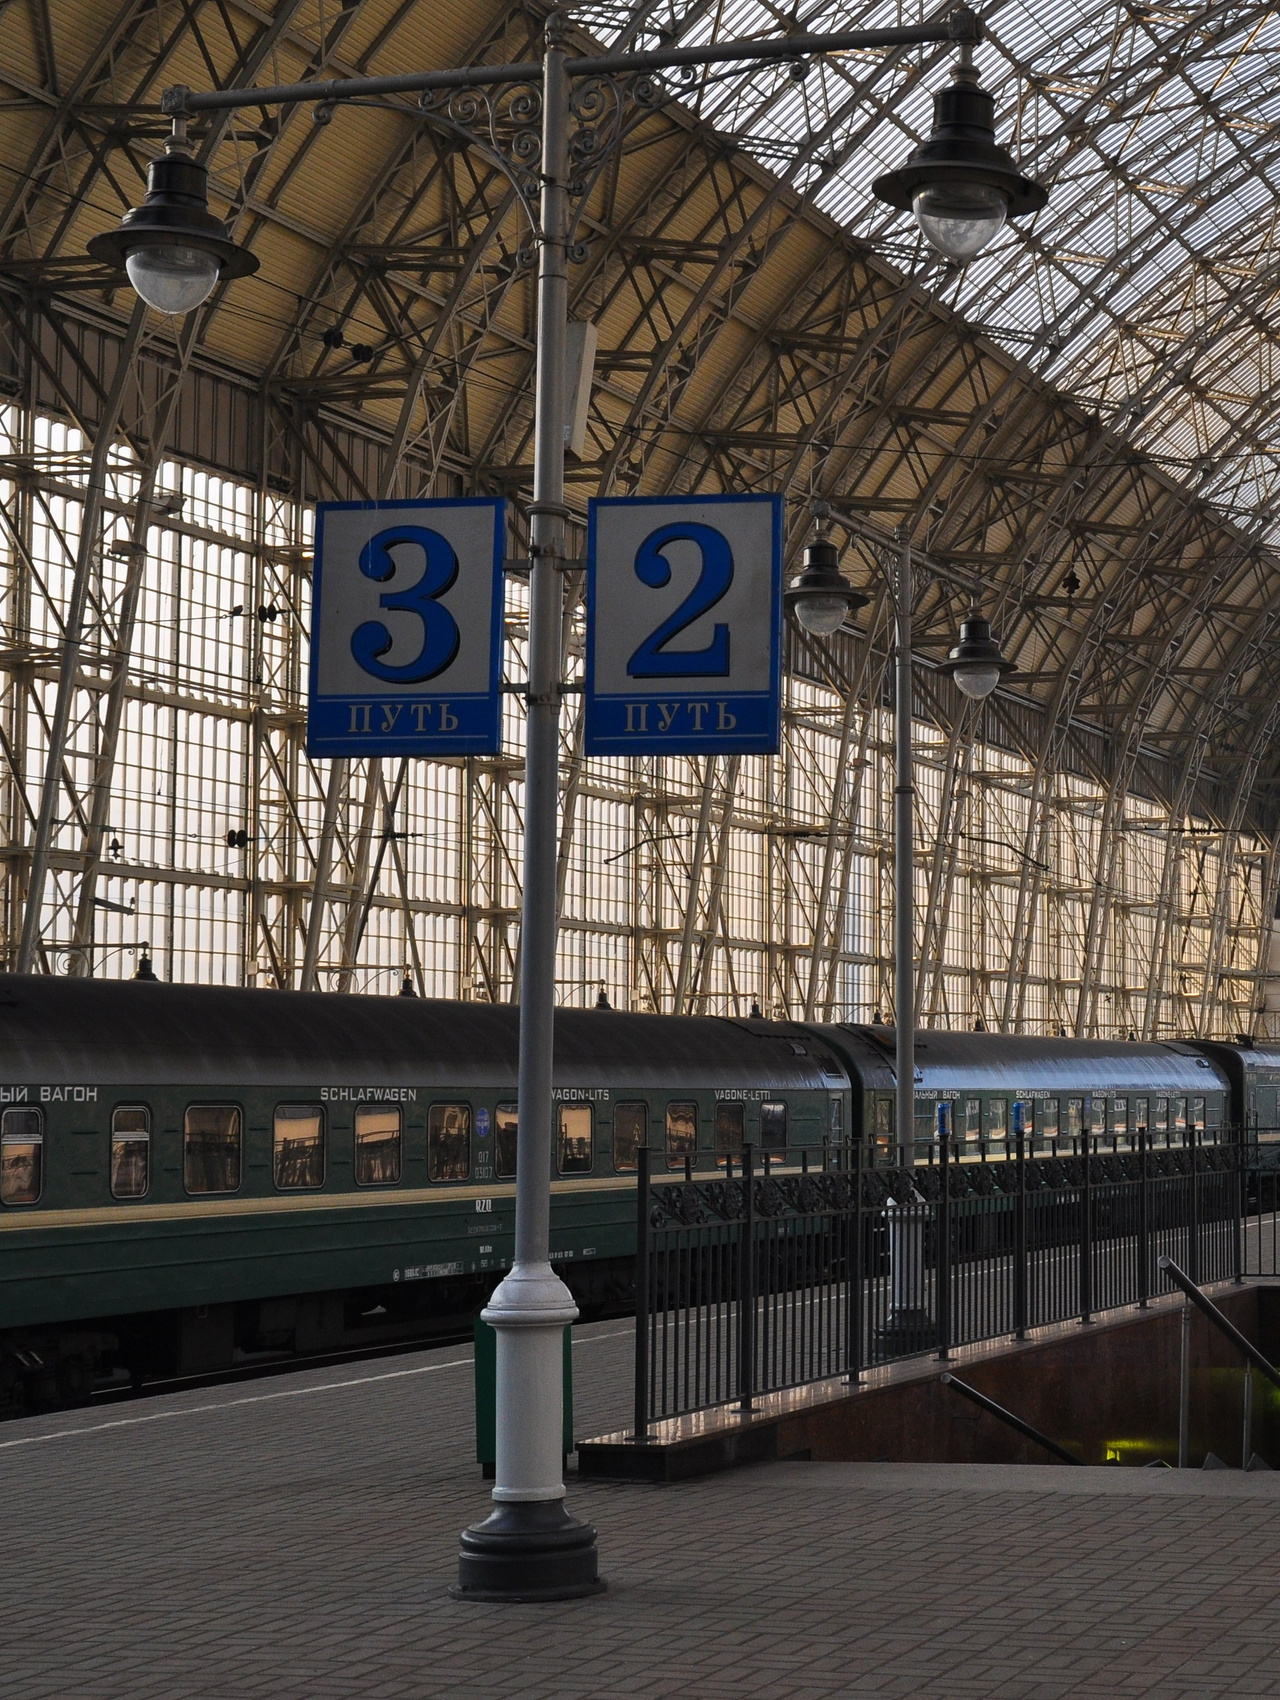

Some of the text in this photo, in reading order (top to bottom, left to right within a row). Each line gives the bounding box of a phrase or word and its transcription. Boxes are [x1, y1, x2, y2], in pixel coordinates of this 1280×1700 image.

[350, 525, 460, 684] 3
[626, 521, 735, 679] 2
[347, 703, 459, 733] ПУТЬ
[624, 701, 737, 732] ПУТЬ
[40, 1086, 97, 1101] ВАГОН
[320, 1087, 417, 1101] SCHLAFWAGEN
[913, 1090, 938, 1100] АЛЬНЫЙ
